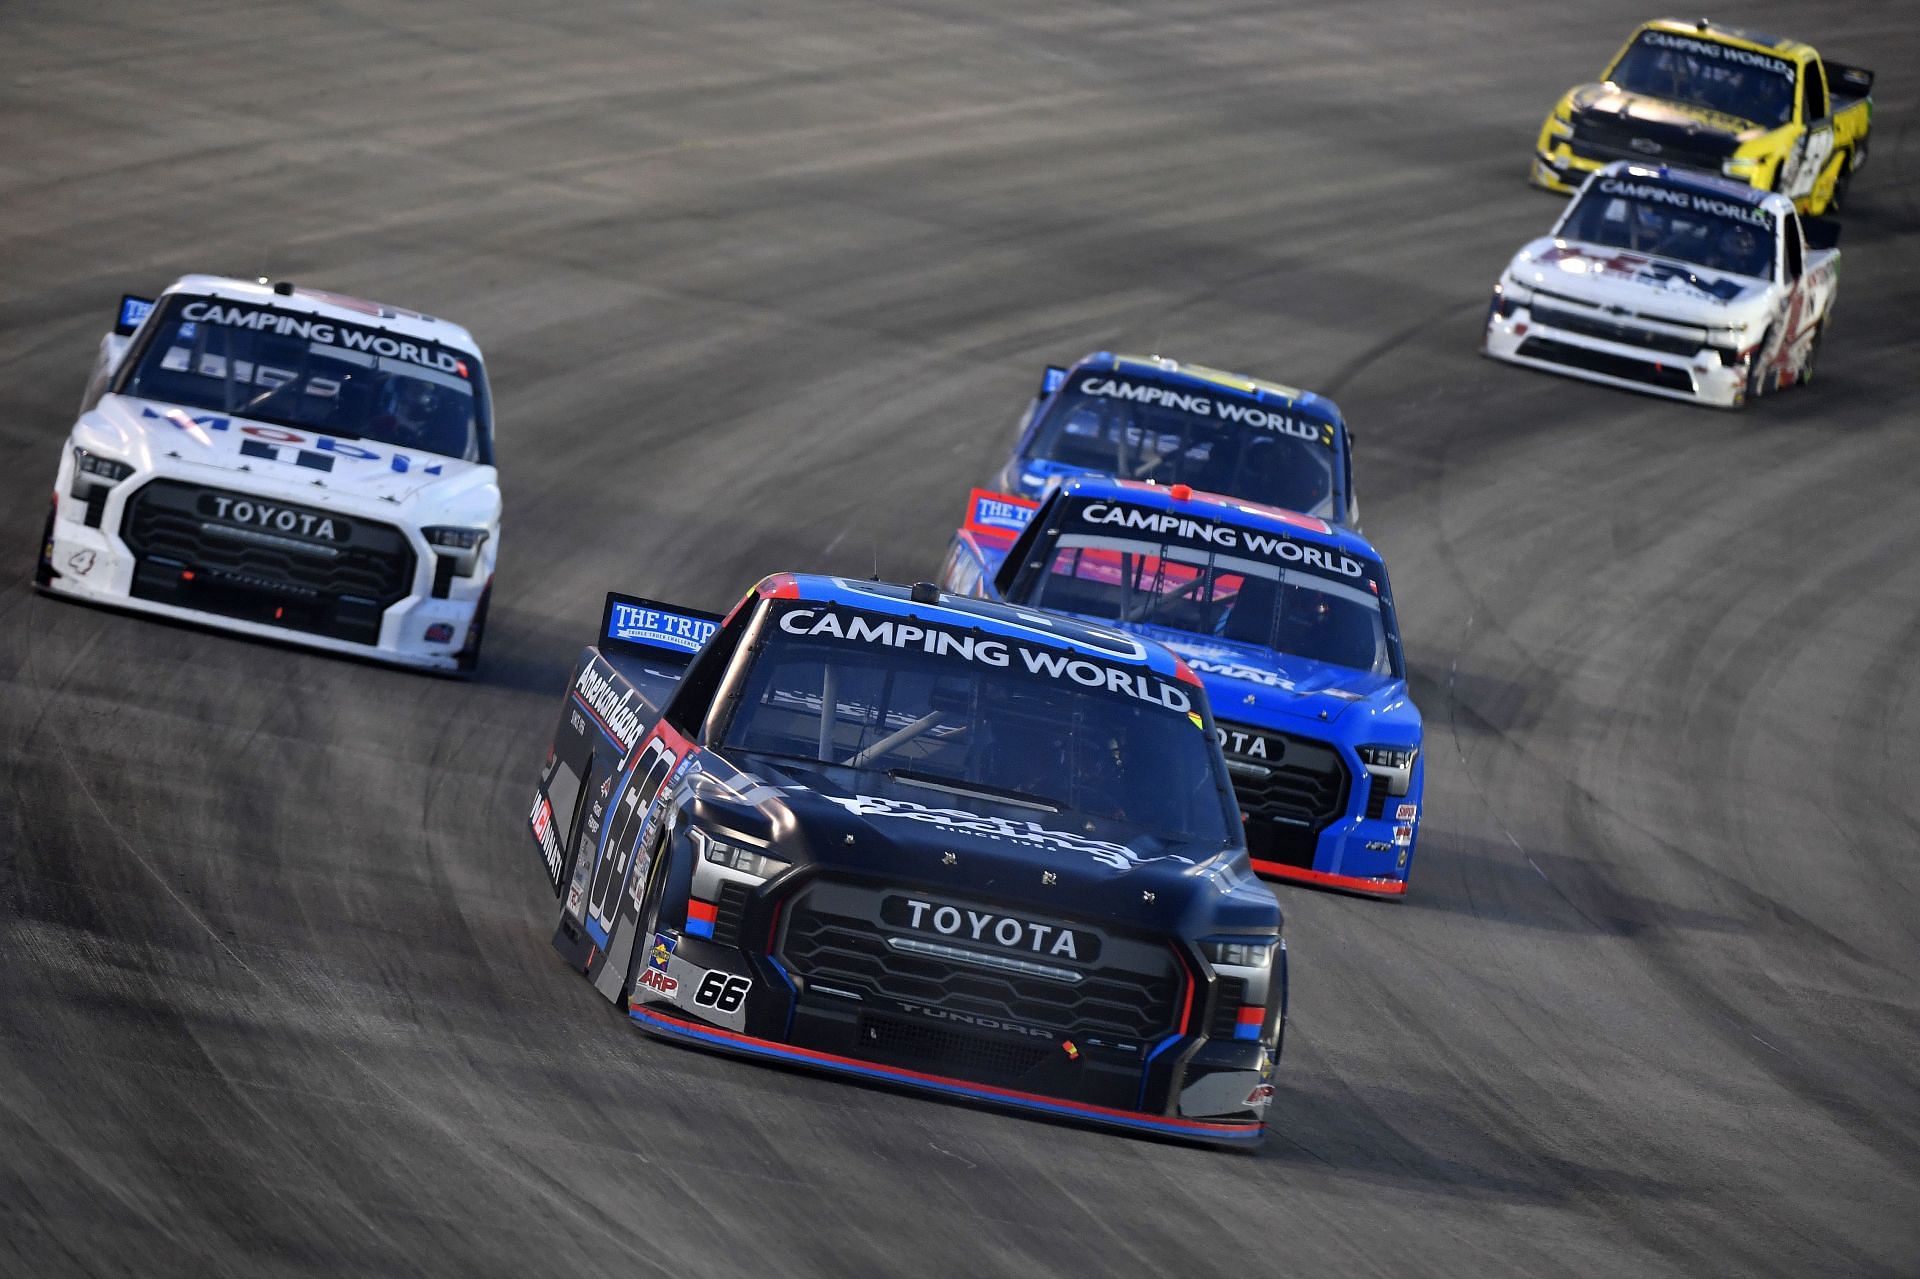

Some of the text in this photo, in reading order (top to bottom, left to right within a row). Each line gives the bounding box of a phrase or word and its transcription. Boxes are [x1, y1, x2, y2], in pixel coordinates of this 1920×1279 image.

[1644, 32, 1788, 74] CAMPING WORLD
[1600, 179, 1767, 228] CAMPING WORLD
[181, 302, 459, 373] CAMPING WORLD
[1081, 378, 1211, 415] CAMPING
[1216, 402, 1320, 441] WORLD
[215, 497, 336, 540] TOYOTA
[979, 498, 1011, 517] THE
[68, 548, 98, 576] 4
[1082, 504, 1364, 577] CAMPING WORLD
[616, 605, 716, 644] THE TRIP
[779, 609, 1010, 667] CAMPING
[1019, 646, 1192, 714] WORLD
[907, 900, 1078, 960] TOYOTA
[639, 969, 678, 993] ARP
[693, 969, 753, 1015] 66
[897, 1002, 1054, 1039] TUNDRA
